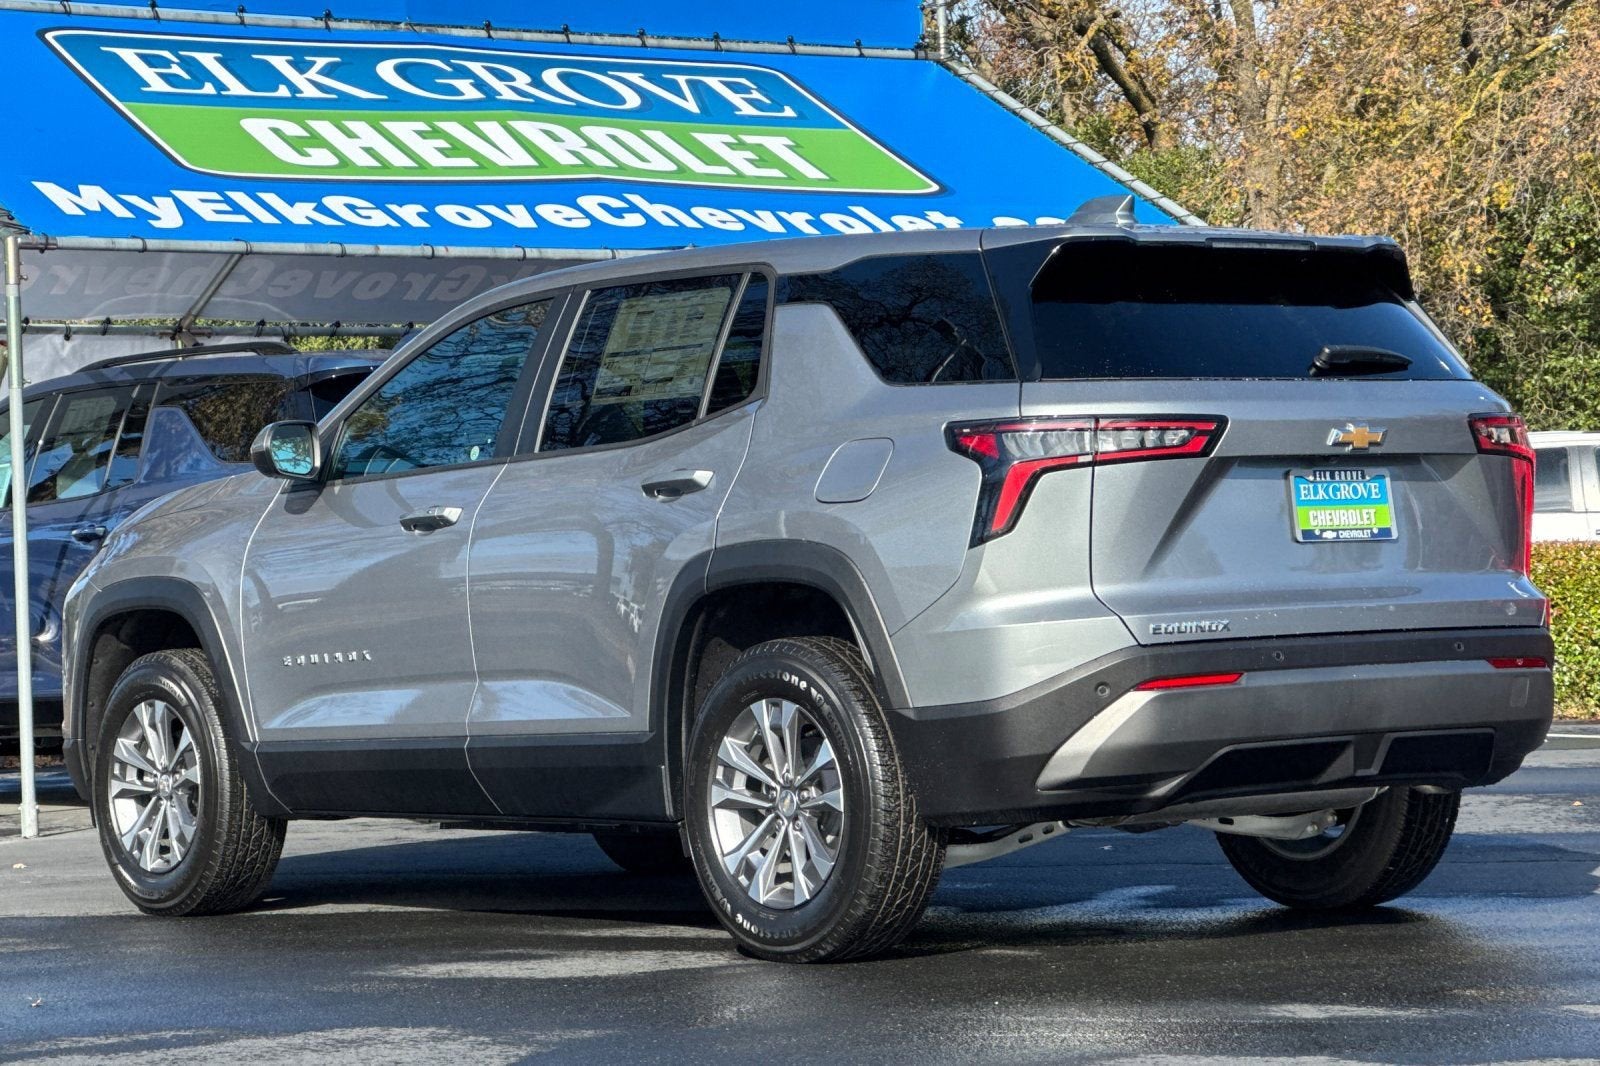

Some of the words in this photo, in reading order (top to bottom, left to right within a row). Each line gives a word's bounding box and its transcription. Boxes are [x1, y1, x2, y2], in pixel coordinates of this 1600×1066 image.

[101, 46, 388, 100] ELK
[375, 57, 797, 119] GROVE
[240, 117, 830, 180] CHEVROLET
[31, 181, 1067, 235] MyElkGroveChevrolet
[1315, 470, 1331, 481] ELK
[1335, 470, 1363, 480] GROVE
[1299, 483, 1329, 501] ELK
[1329, 482, 1381, 500] GROVE
[1309, 508, 1377, 527] CHEVROLET
[1338, 529, 1371, 539] CHEVROLET
[1151, 619, 1231, 635] EQUINOX
